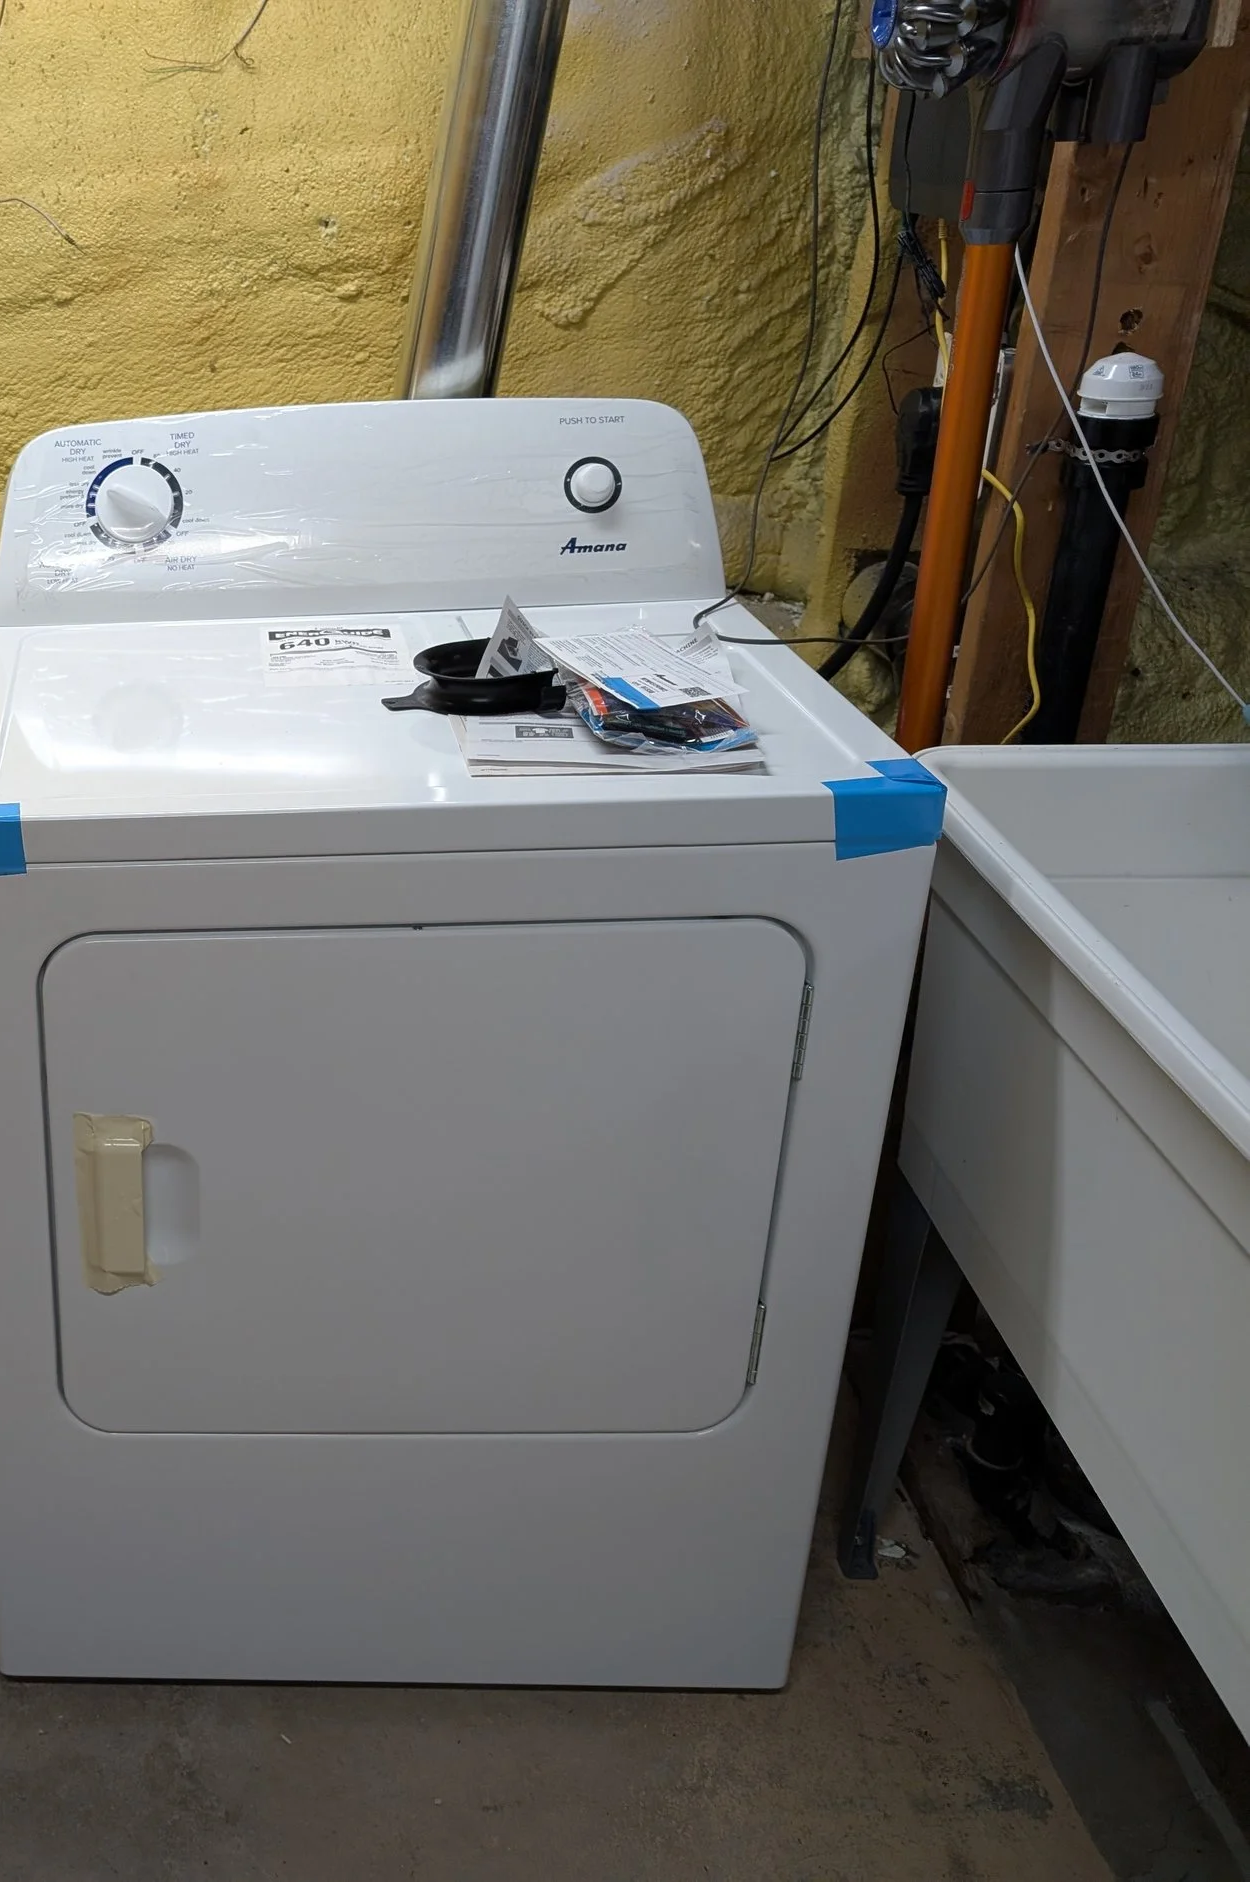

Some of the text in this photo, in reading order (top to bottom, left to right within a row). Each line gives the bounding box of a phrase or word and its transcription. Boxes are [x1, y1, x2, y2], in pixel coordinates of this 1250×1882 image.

[559, 415, 625, 425] PUSH TO START
[170, 432, 195, 440] TIMED
[54, 439, 102, 448] AUTOMATIC
[174, 441, 191, 449] DRY
[559, 536, 627, 556] Amana
[279, 637, 331, 650] 640
[675, 637, 699, 653] ACHINE
